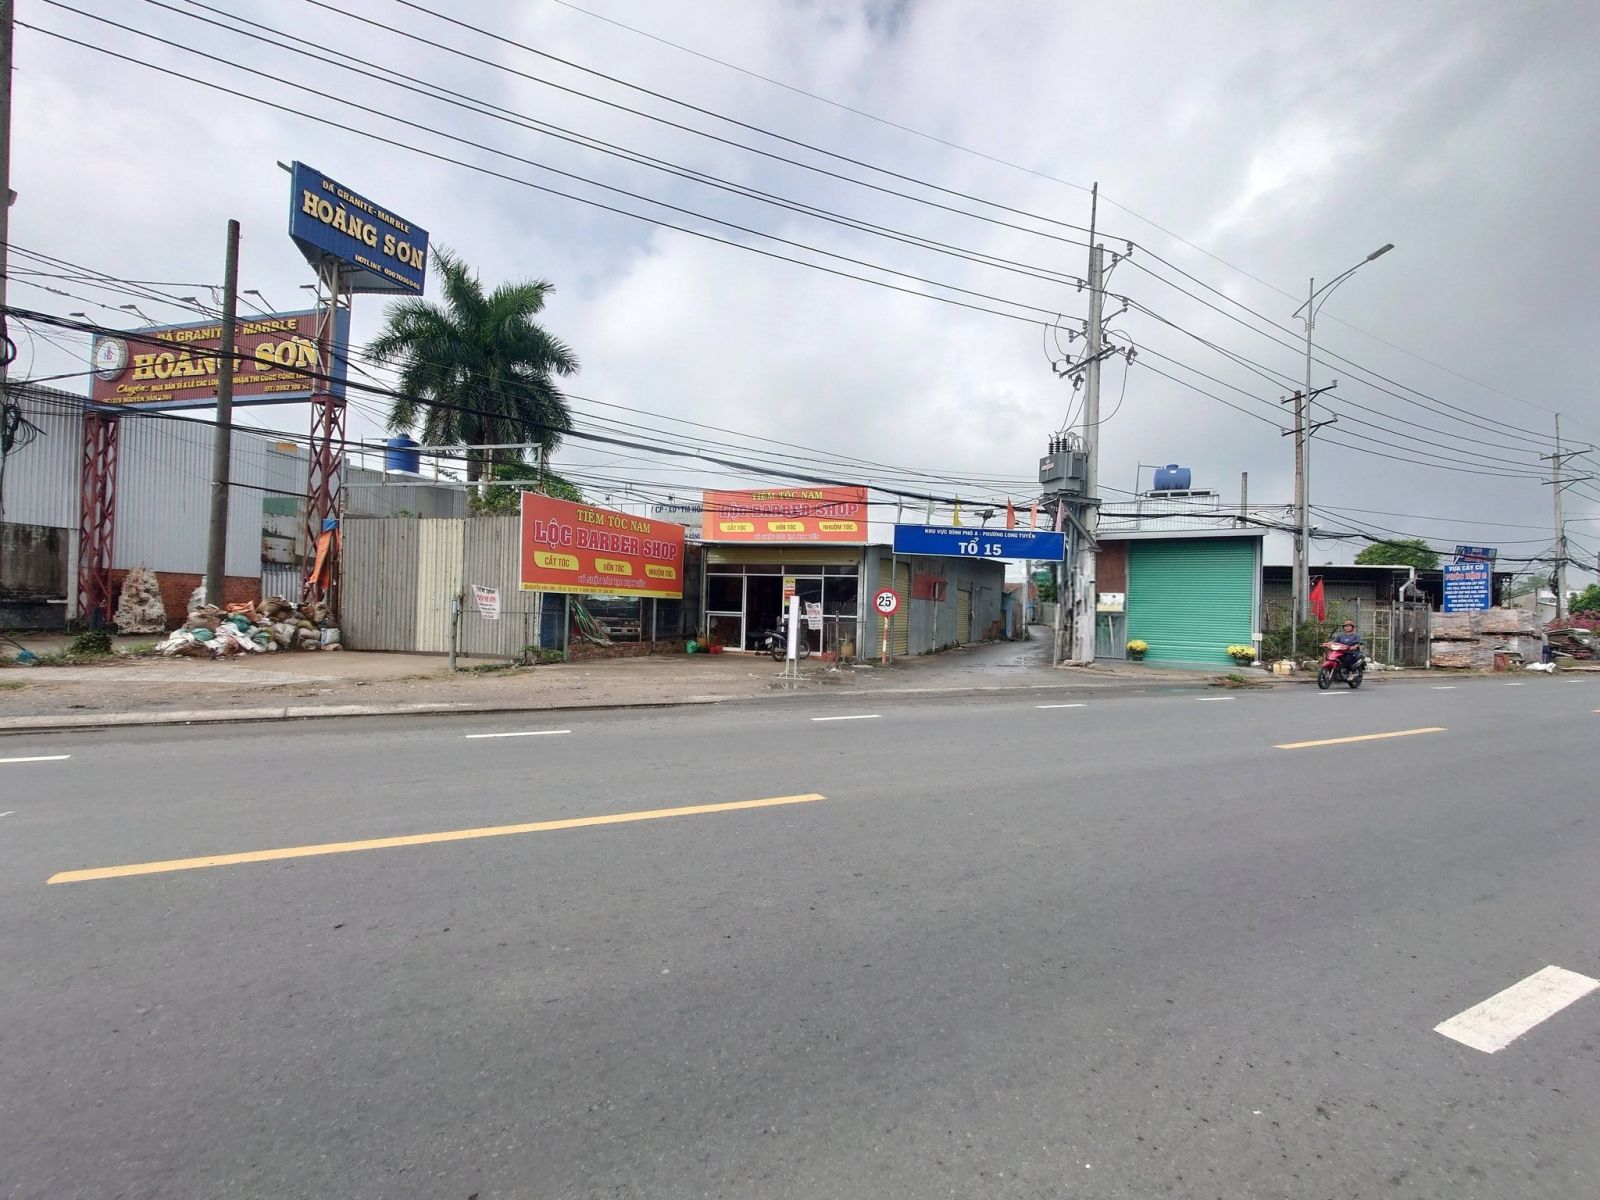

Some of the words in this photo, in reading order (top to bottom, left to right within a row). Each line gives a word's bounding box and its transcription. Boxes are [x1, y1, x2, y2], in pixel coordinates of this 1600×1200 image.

[302, 189, 378, 248] HOÀNG
[383, 233, 424, 271] SƠN
[355, 254, 382, 273] HOTLINE
[177, 326, 223, 342] GRANIT
[243, 319, 297, 335] MARBLE
[255, 336, 319, 371] SƠN
[801, 491, 823, 500] NAM
[815, 503, 860, 518] SHOP
[576, 509, 605, 526] TIỆM
[608, 514, 627, 530] TÓC
[630, 521, 651, 534] NAM
[534, 518, 573, 549] LỘC
[576, 527, 640, 556] BARBER
[642, 539, 678, 561] SHOP
[958, 537, 979, 555] TỔ
[984, 543, 1002, 556] 15
[544, 555, 556, 567] CẮT
[557, 557, 570, 568] TÓC
